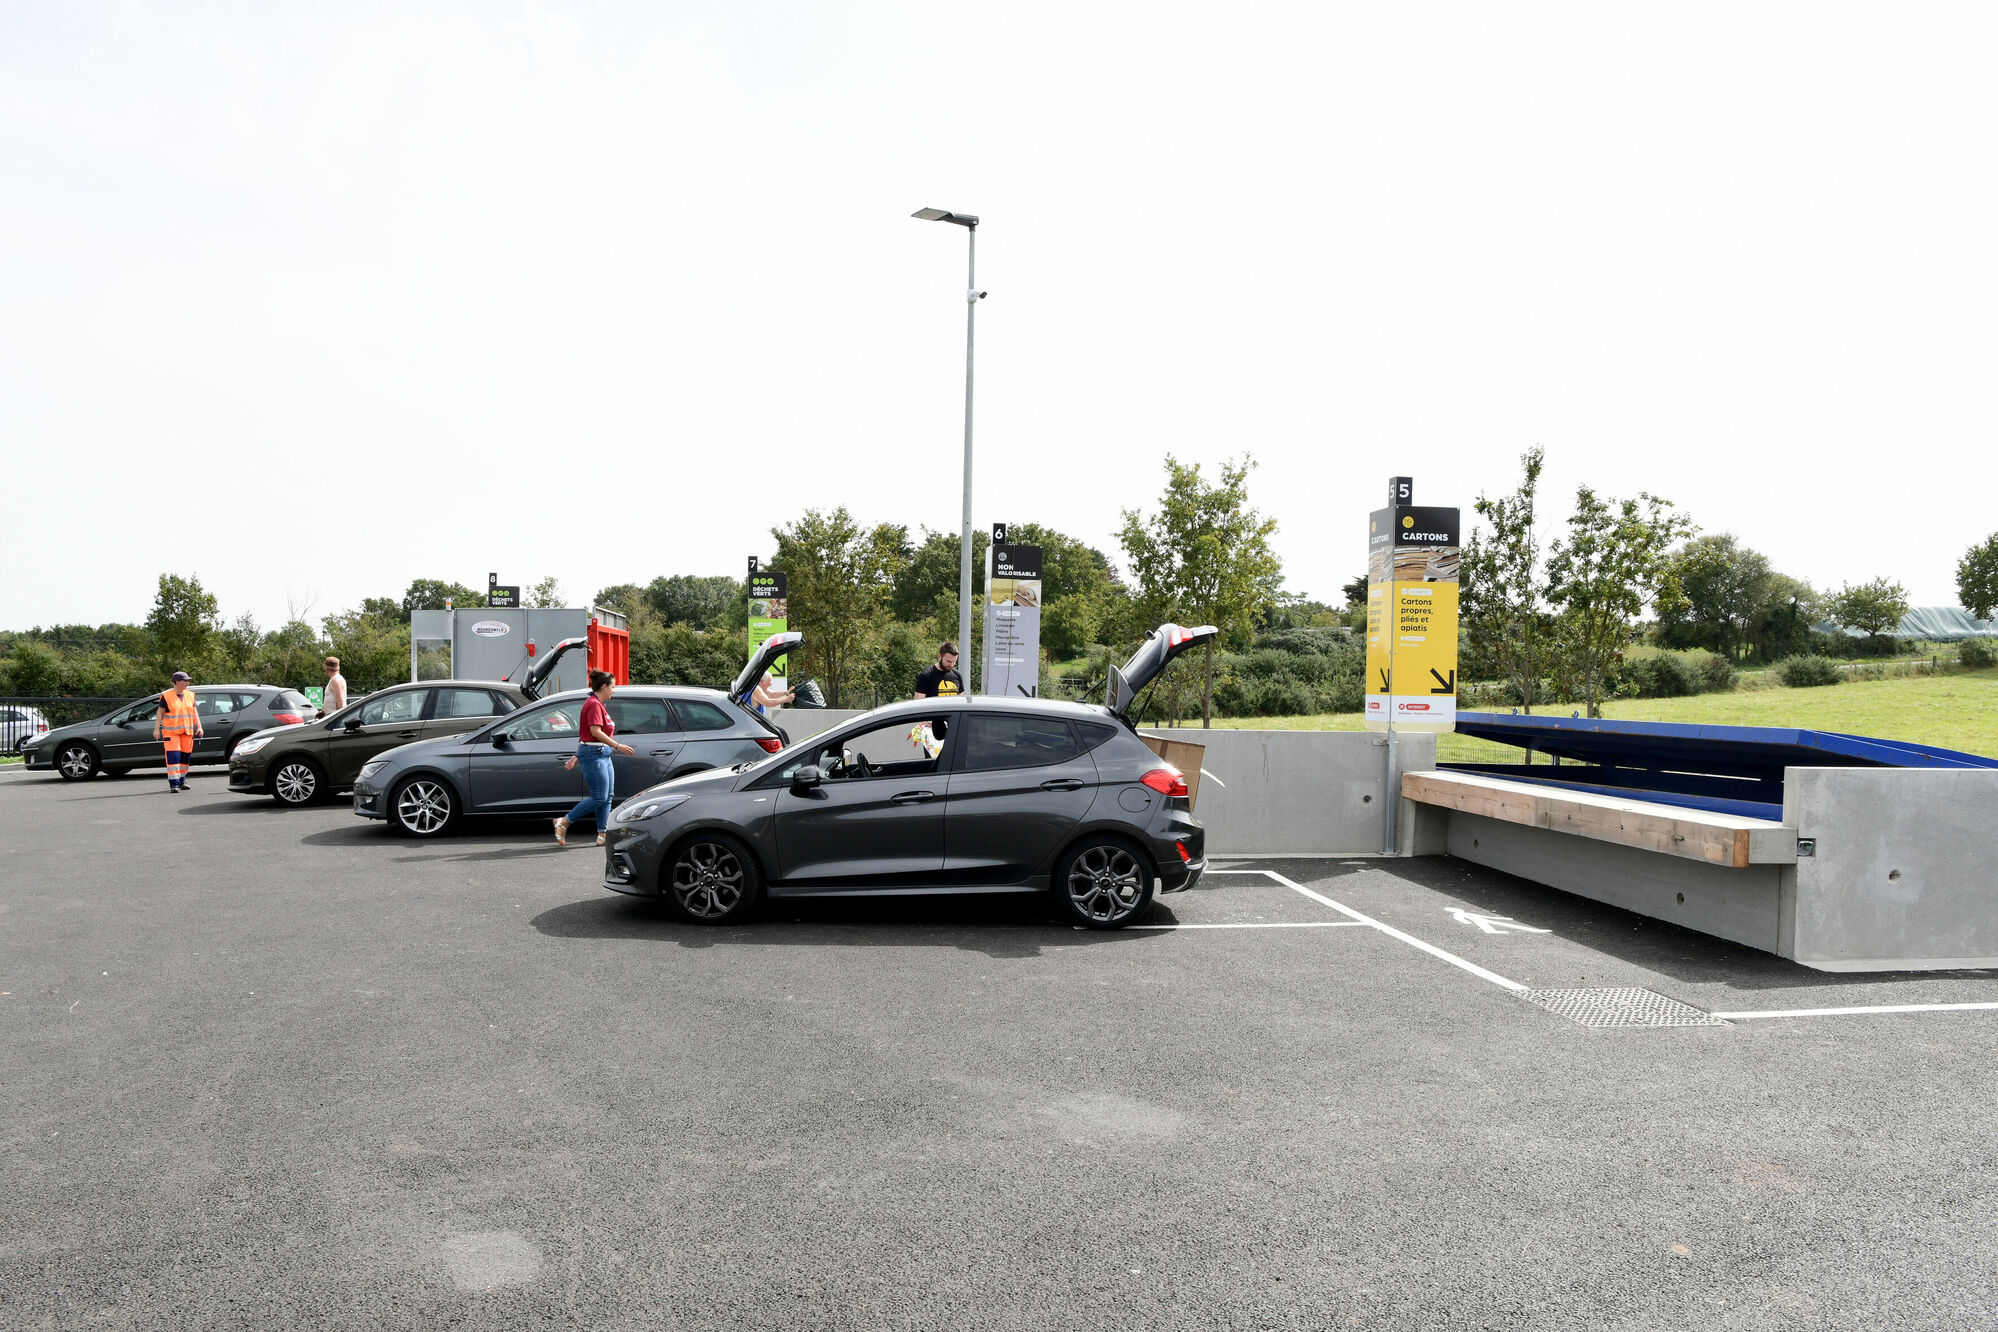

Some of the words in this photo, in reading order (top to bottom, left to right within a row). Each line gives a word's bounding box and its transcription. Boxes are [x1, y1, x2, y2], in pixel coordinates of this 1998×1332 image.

[1390, 484, 1394, 498] 5
[1399, 483, 1410, 498] 5
[995, 528, 1003, 539] 6
[1402, 532, 1449, 541] CARTONS
[750, 560, 756, 568] 7
[1401, 598, 1432, 606] Cartons
[1400, 614, 1419, 624] pliés
